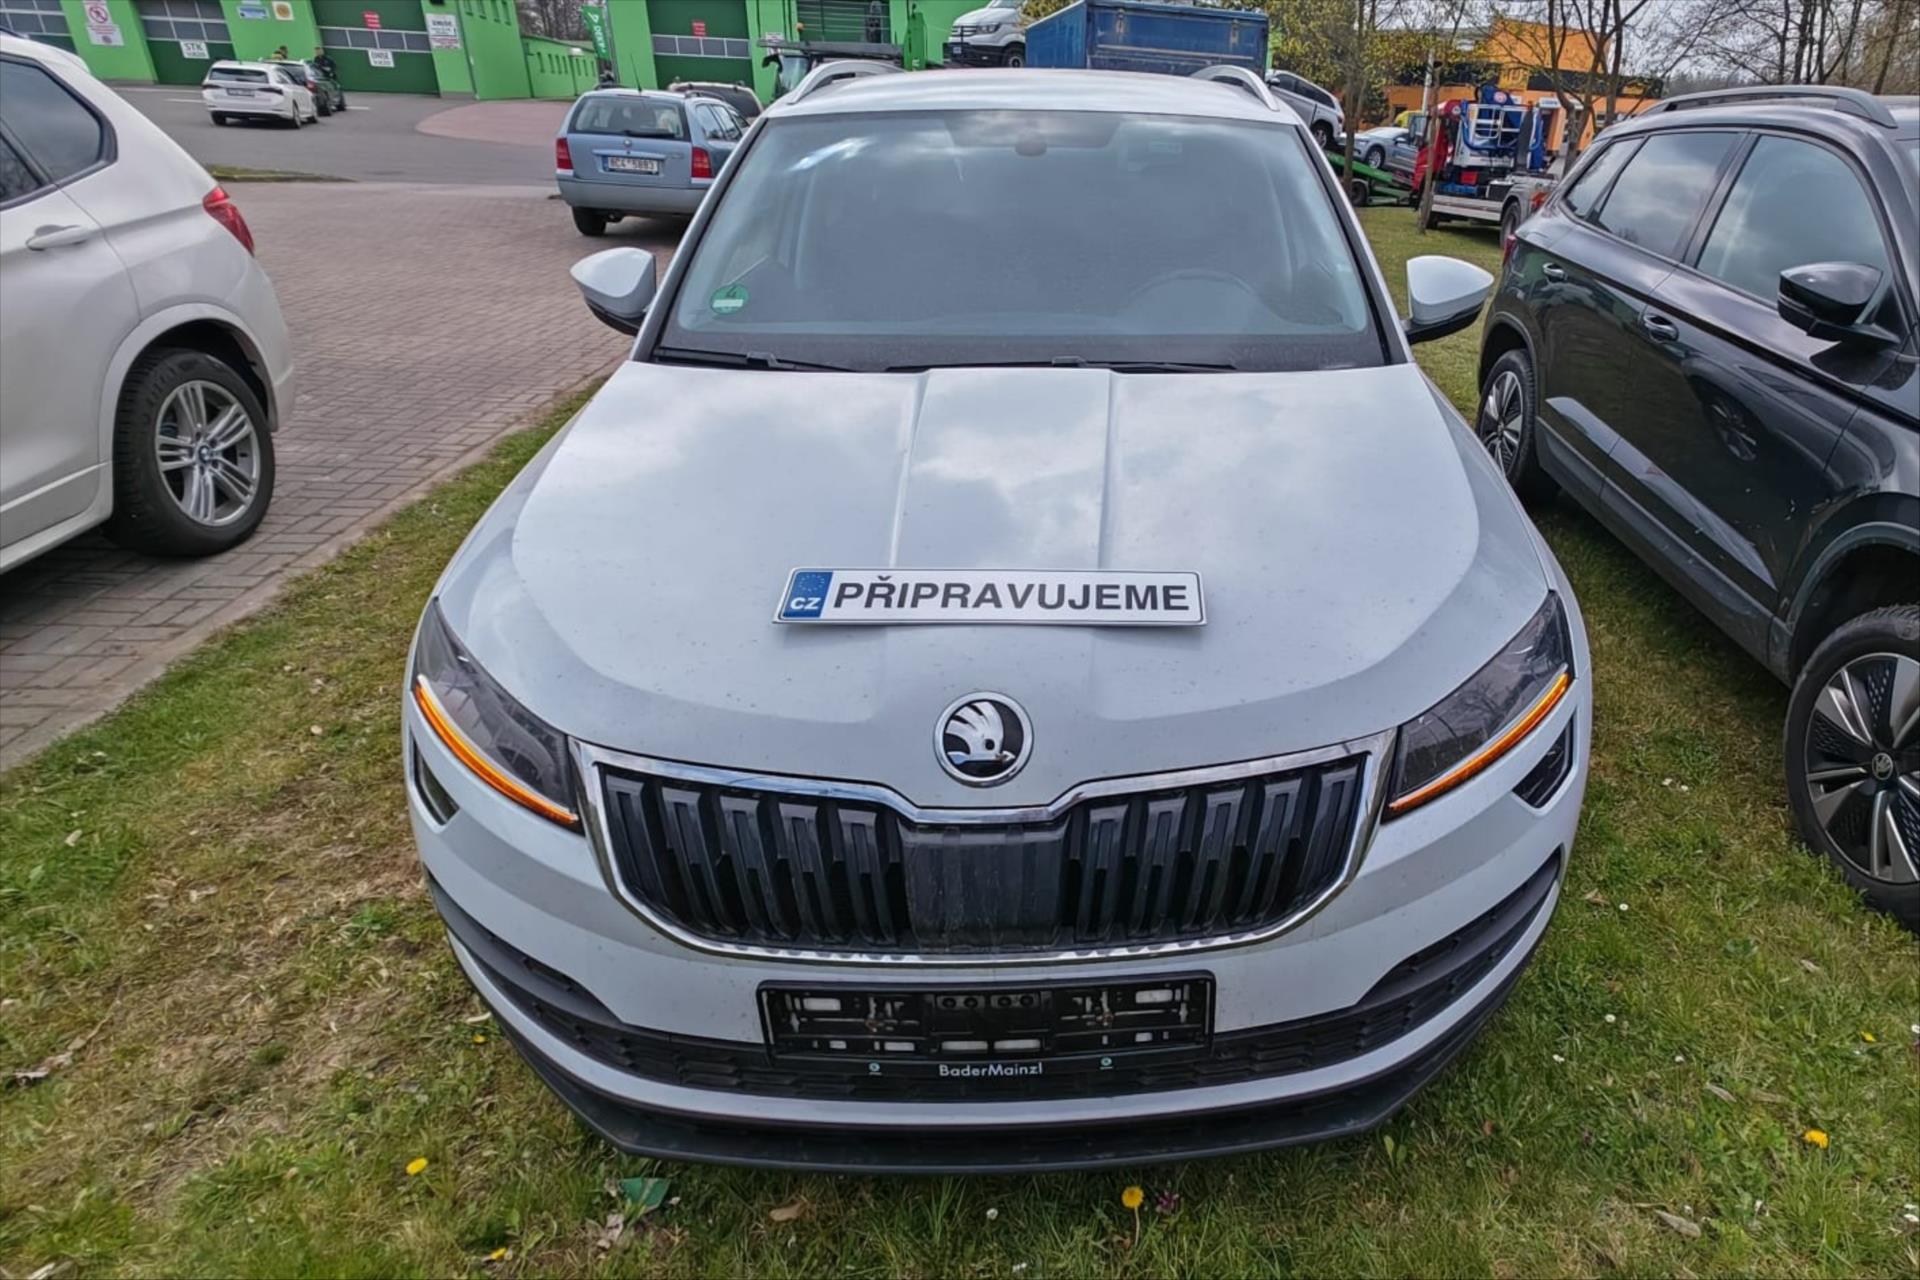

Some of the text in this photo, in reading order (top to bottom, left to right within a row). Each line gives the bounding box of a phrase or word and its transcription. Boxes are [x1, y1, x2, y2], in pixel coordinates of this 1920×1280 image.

[789, 575, 1190, 611] CZ PŘIPRAVUJEME
[938, 1062, 1043, 1077] BaderMainzl
